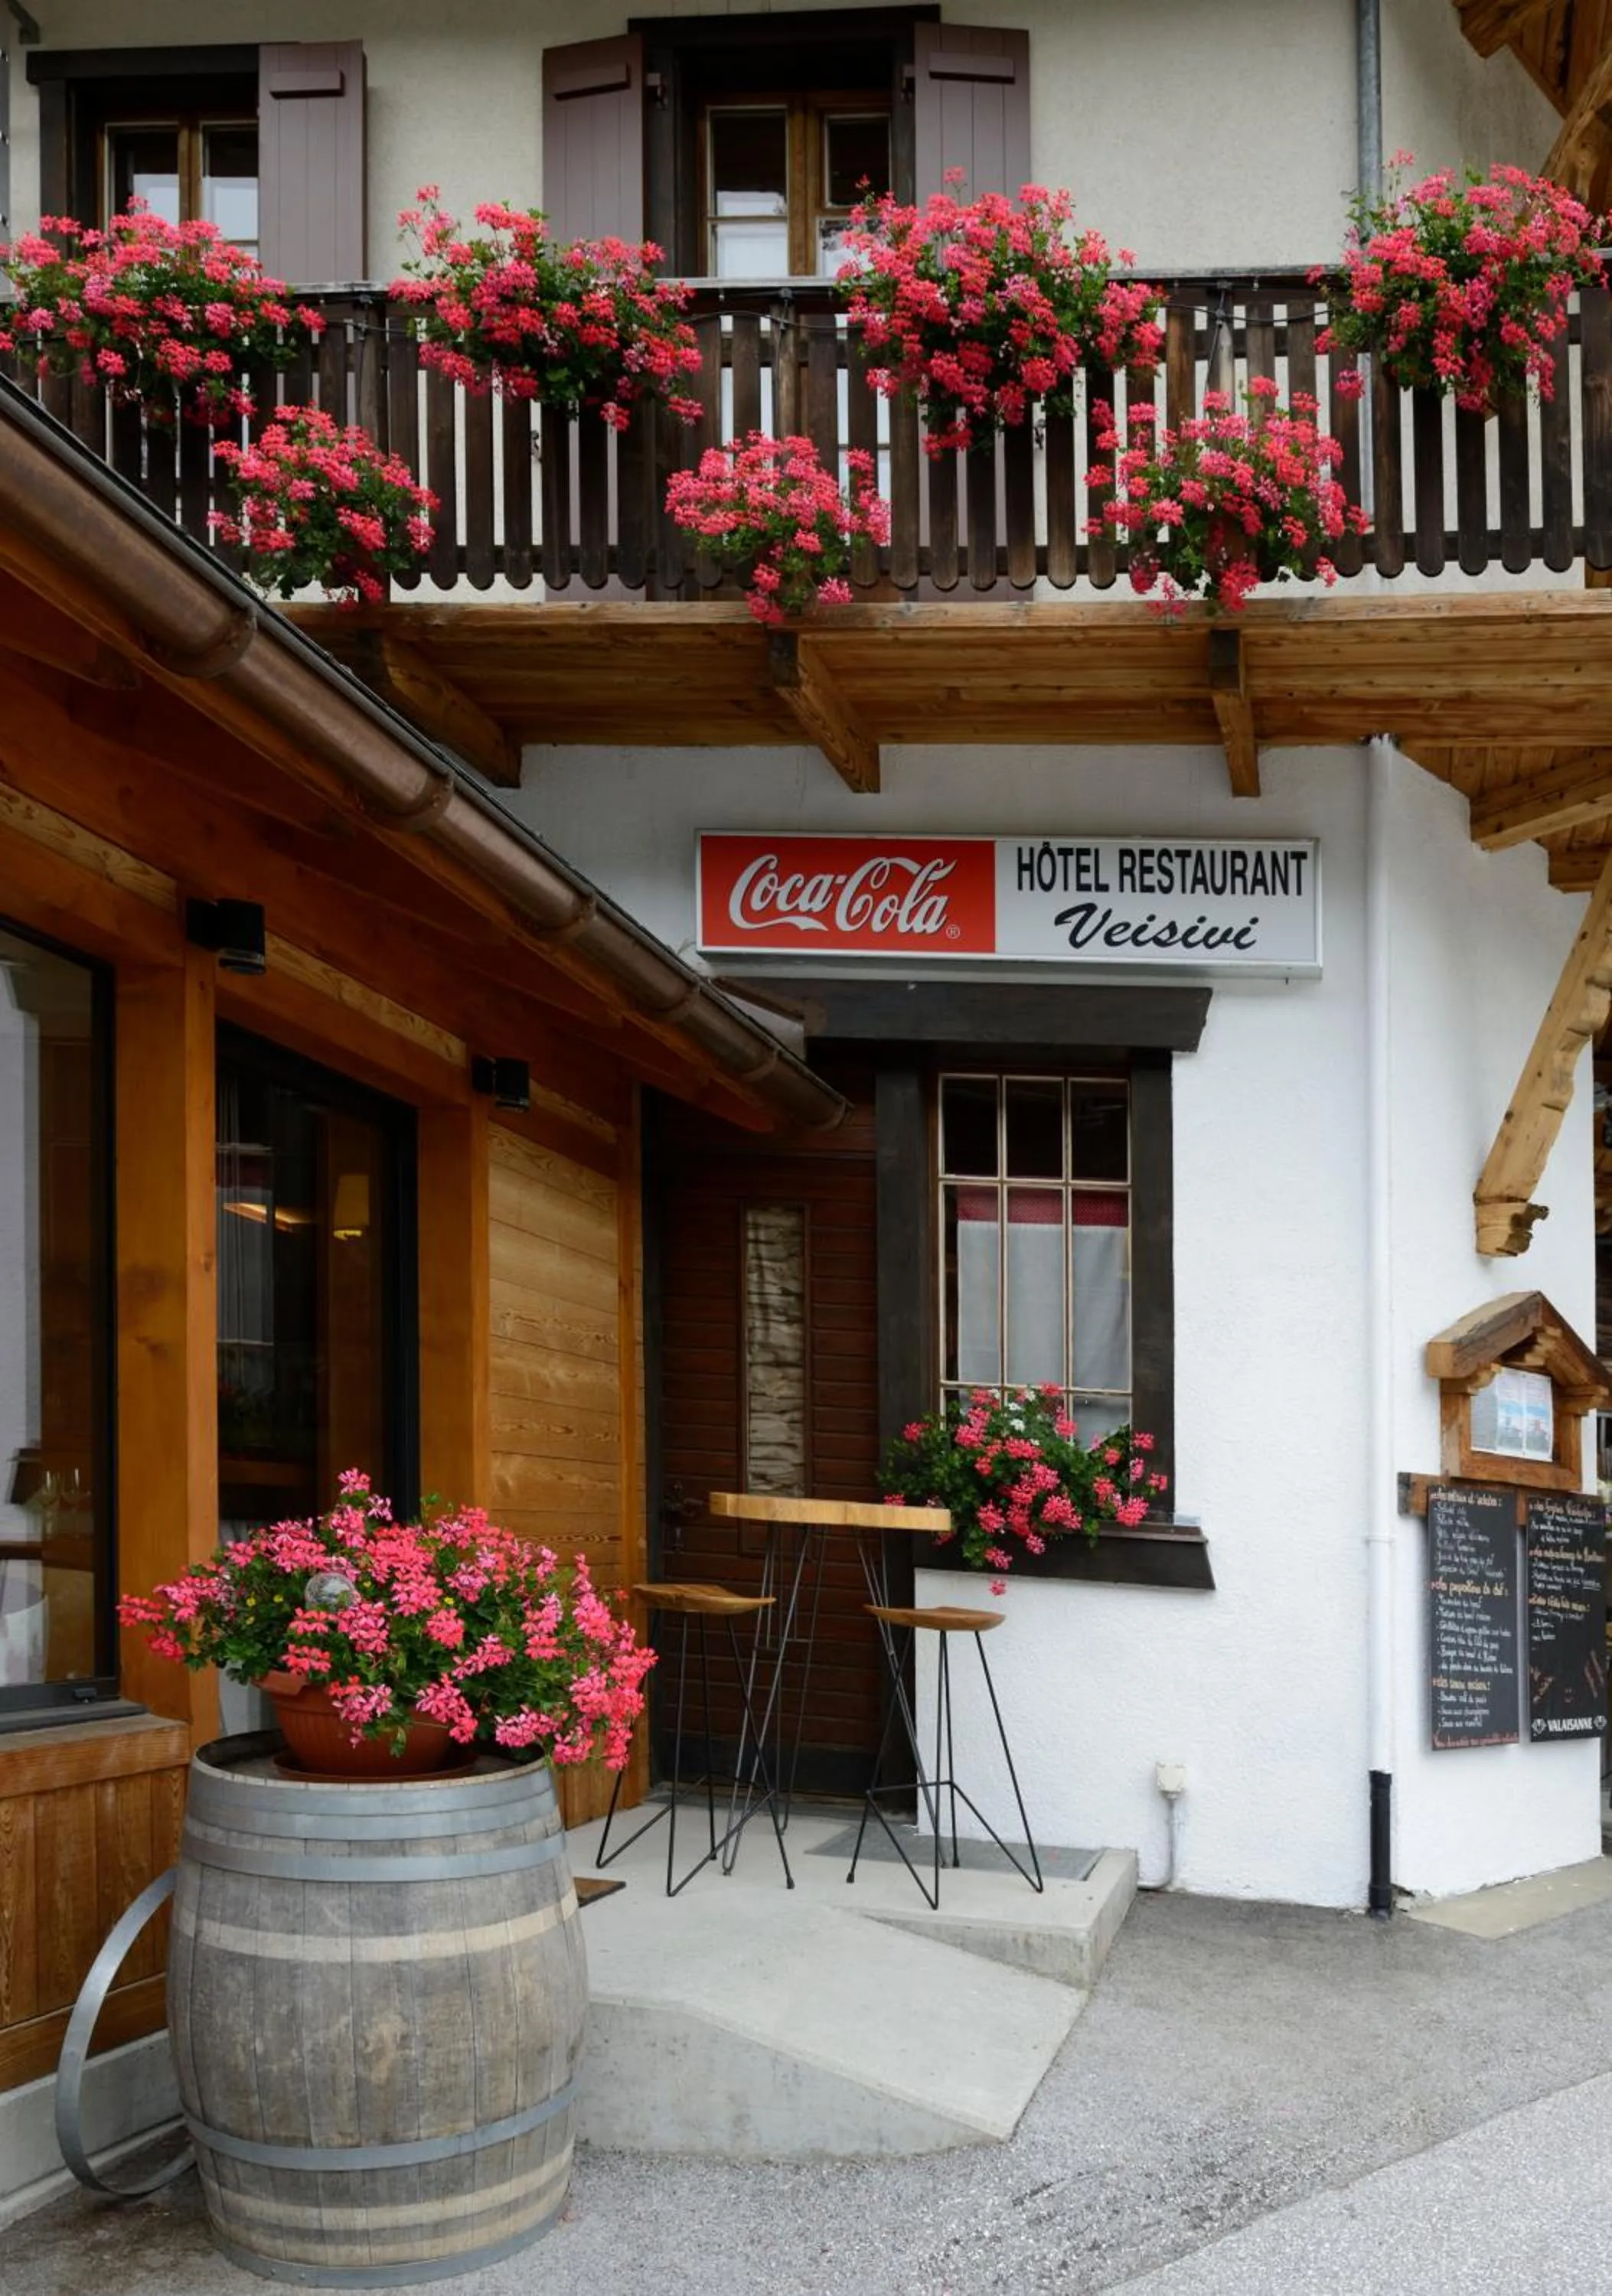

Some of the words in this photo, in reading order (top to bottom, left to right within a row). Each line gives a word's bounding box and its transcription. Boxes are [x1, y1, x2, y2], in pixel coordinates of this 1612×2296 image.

[729, 854, 957, 934] Coca-Cola
[1017, 842, 1109, 892] HÔTEL
[1118, 847, 1308, 896] RESTAURANT
[1054, 902, 1259, 950] Veisivi
[1547, 1717, 1594, 1732] VALAISANNE
